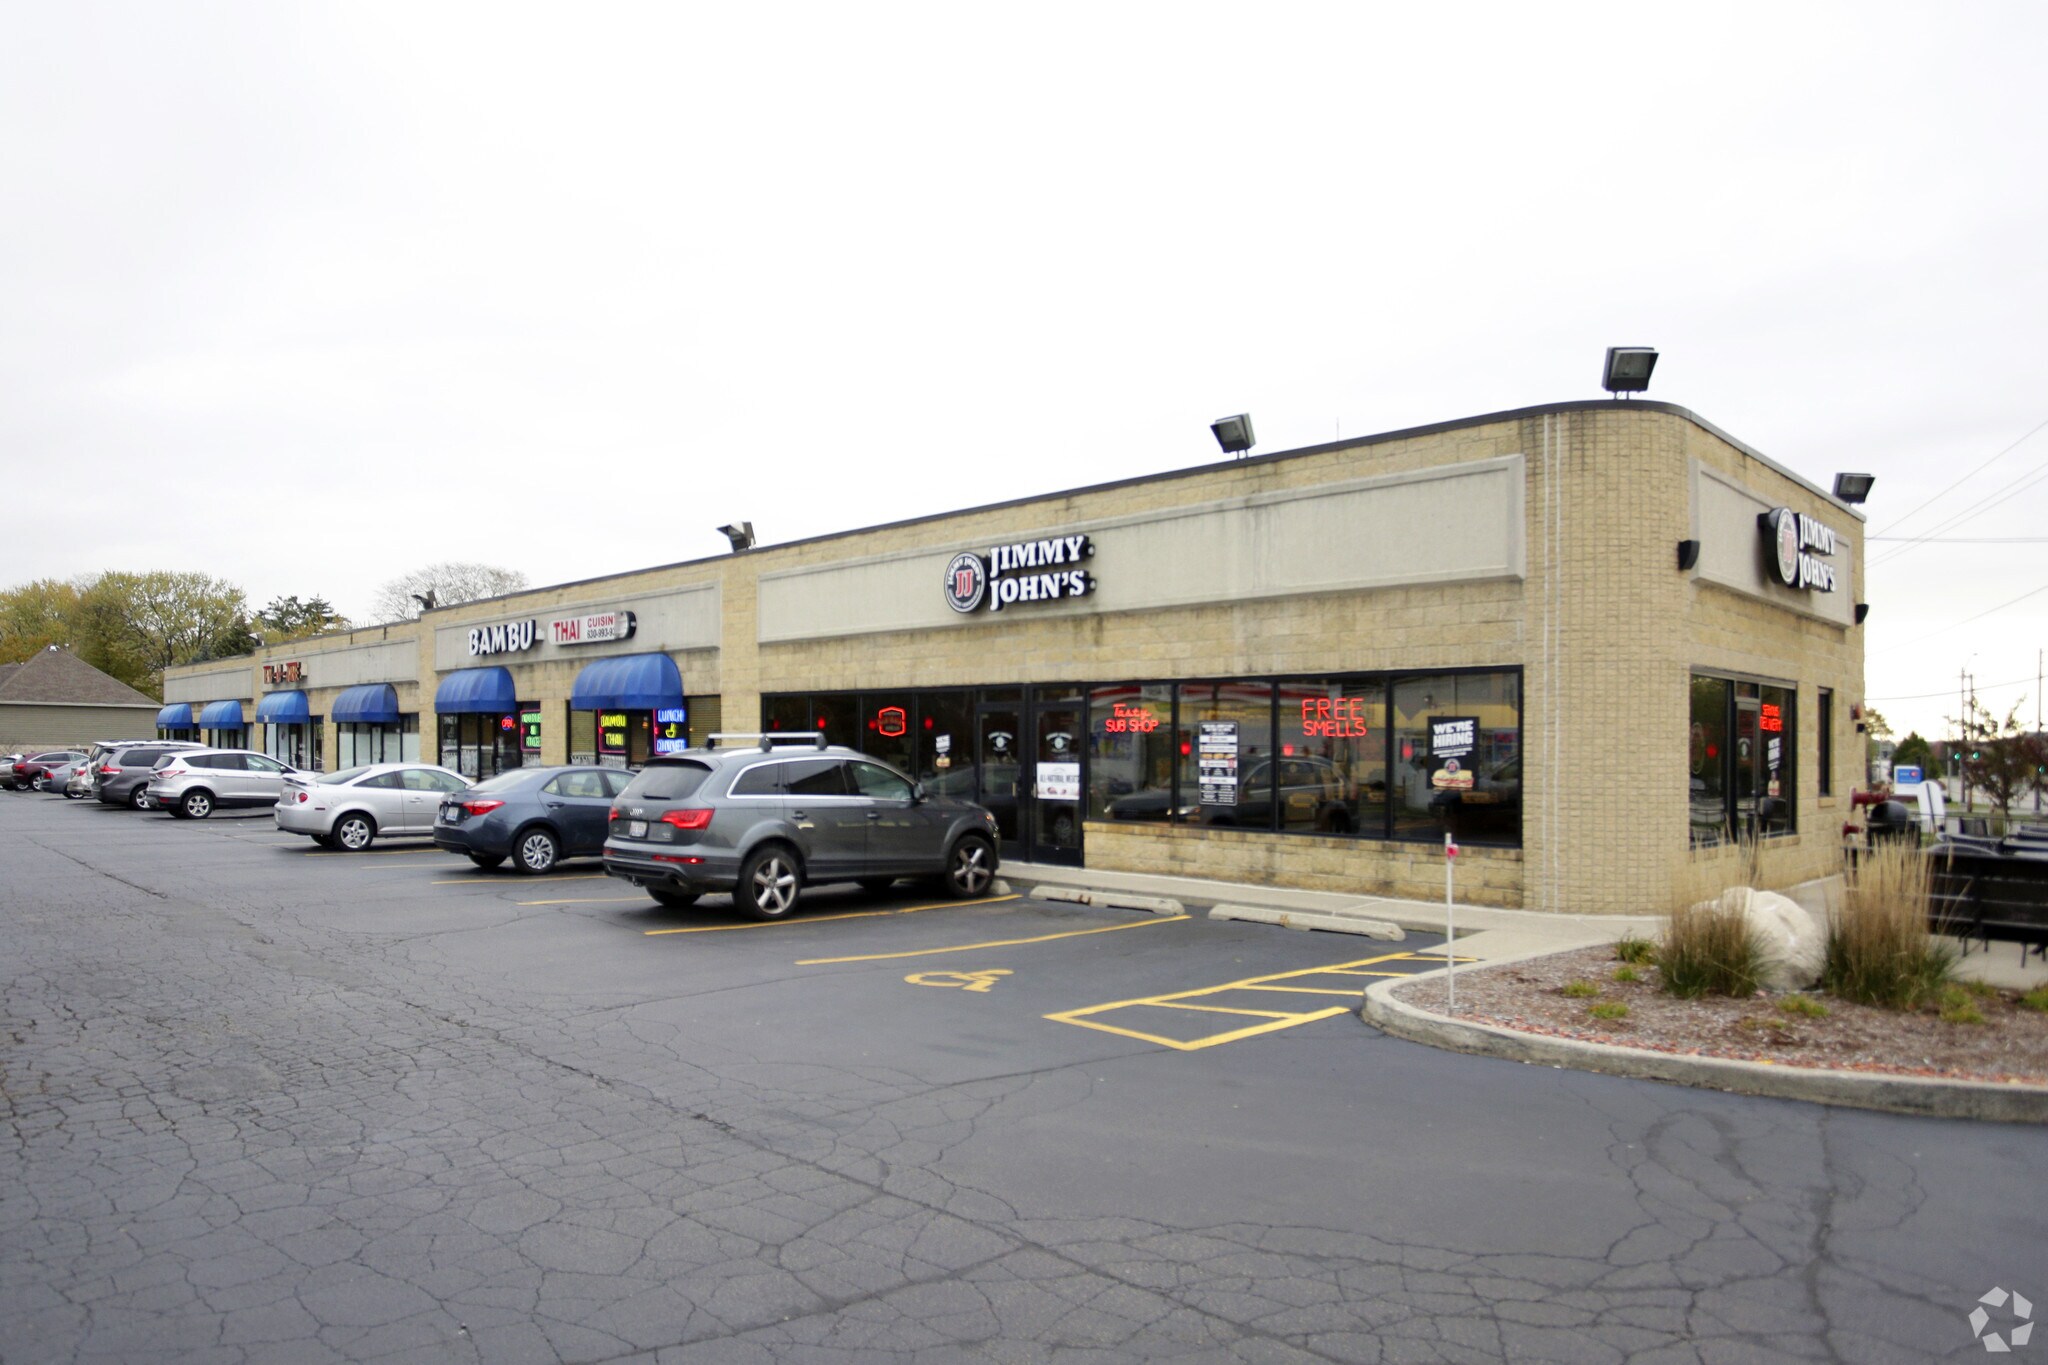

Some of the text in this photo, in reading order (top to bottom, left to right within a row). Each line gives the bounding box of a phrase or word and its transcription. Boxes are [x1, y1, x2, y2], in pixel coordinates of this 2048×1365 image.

[1799, 513, 1835, 555] JIMMY
[989, 535, 1084, 578] JIMMY
[1799, 552, 1836, 592] JOHN'S
[989, 570, 1085, 611] JOHN'S
[587, 615, 615, 628] CUISIN
[468, 619, 533, 656] BAMBU
[553, 619, 580, 642] THAI
[657, 709, 685, 722] LUNCH
[1302, 697, 1364, 720] FREE
[600, 714, 626, 727] BAMBU
[1105, 718, 1160, 733] SUB SHOP
[1303, 720, 1367, 737] SMELLS
[1433, 720, 1474, 735] WE'RE
[605, 733, 624, 746] THAI
[1433, 731, 1474, 748] HIRING
